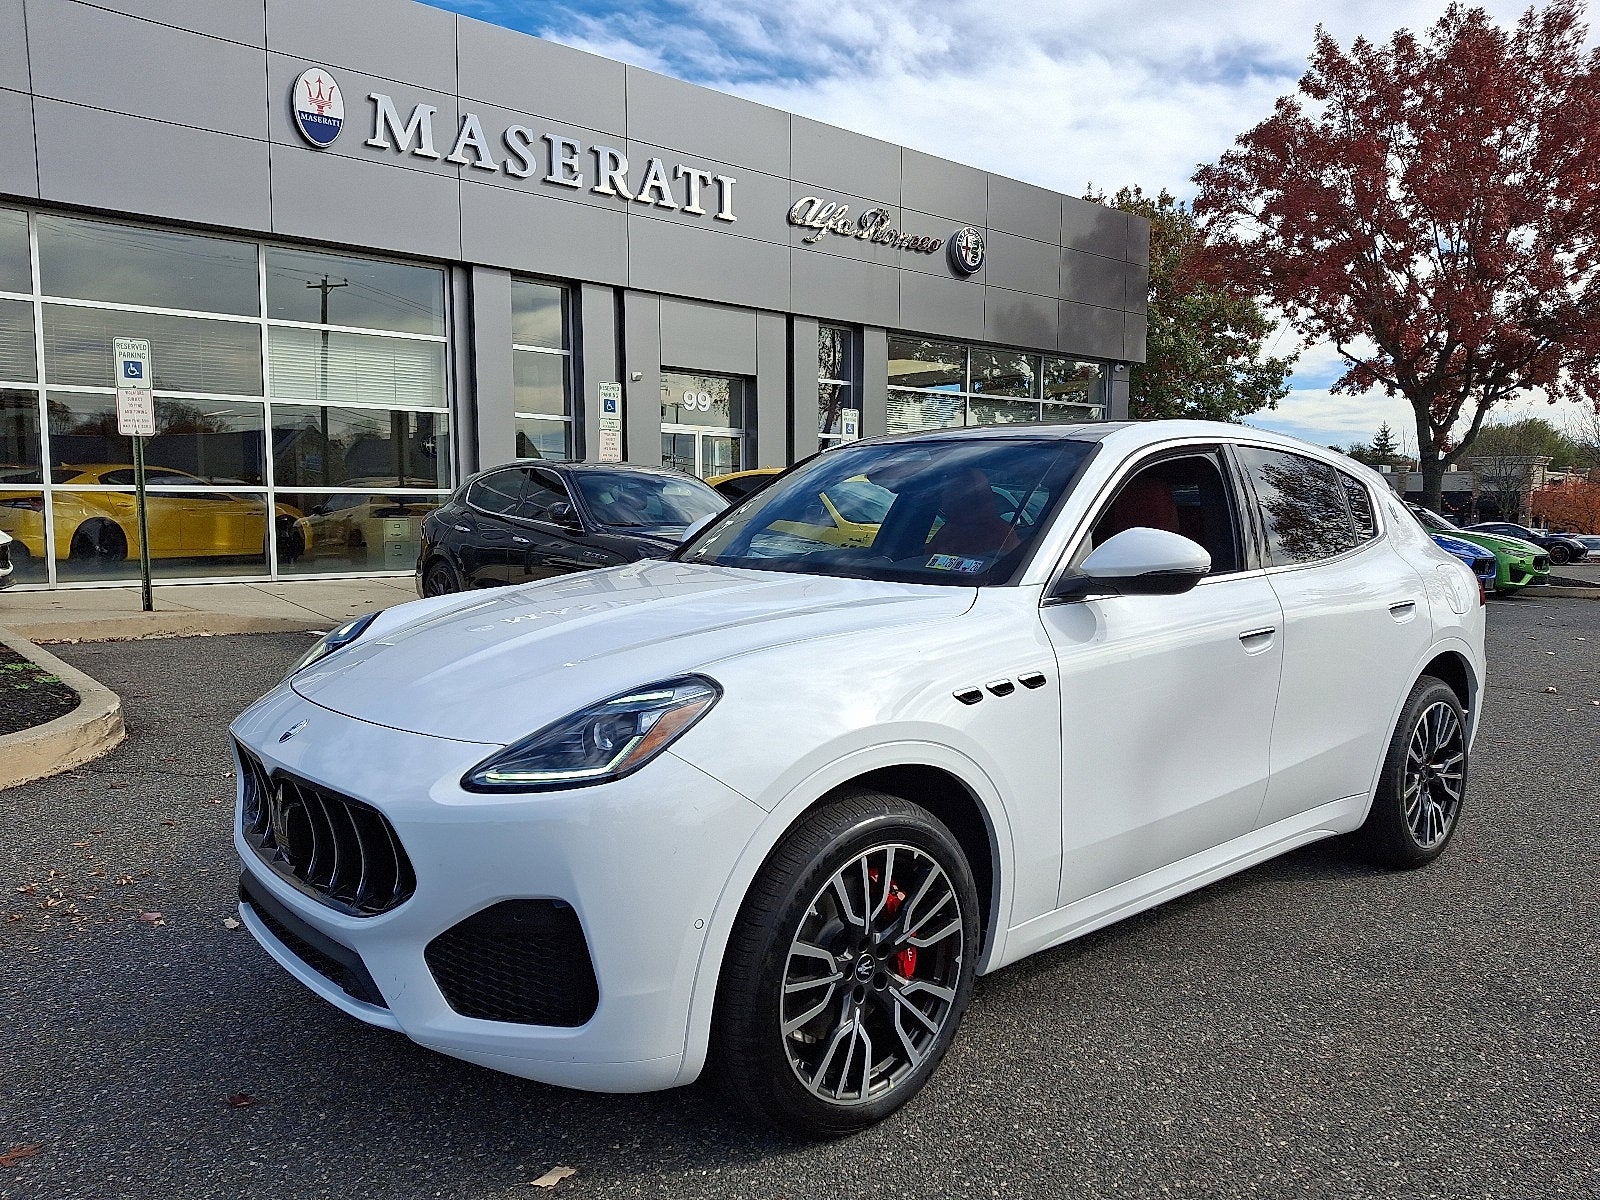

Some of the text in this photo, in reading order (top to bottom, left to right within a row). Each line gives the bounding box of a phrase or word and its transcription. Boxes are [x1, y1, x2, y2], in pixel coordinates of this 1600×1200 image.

[300, 112, 340, 127] MASERATI
[366, 92, 737, 221] MASERATI
[789, 196, 854, 243] Alfa
[853, 207, 945, 253] Romeo
[116, 342, 147, 351] RESERVED
[118, 351, 146, 360] PARKING
[683, 390, 711, 412] 99
